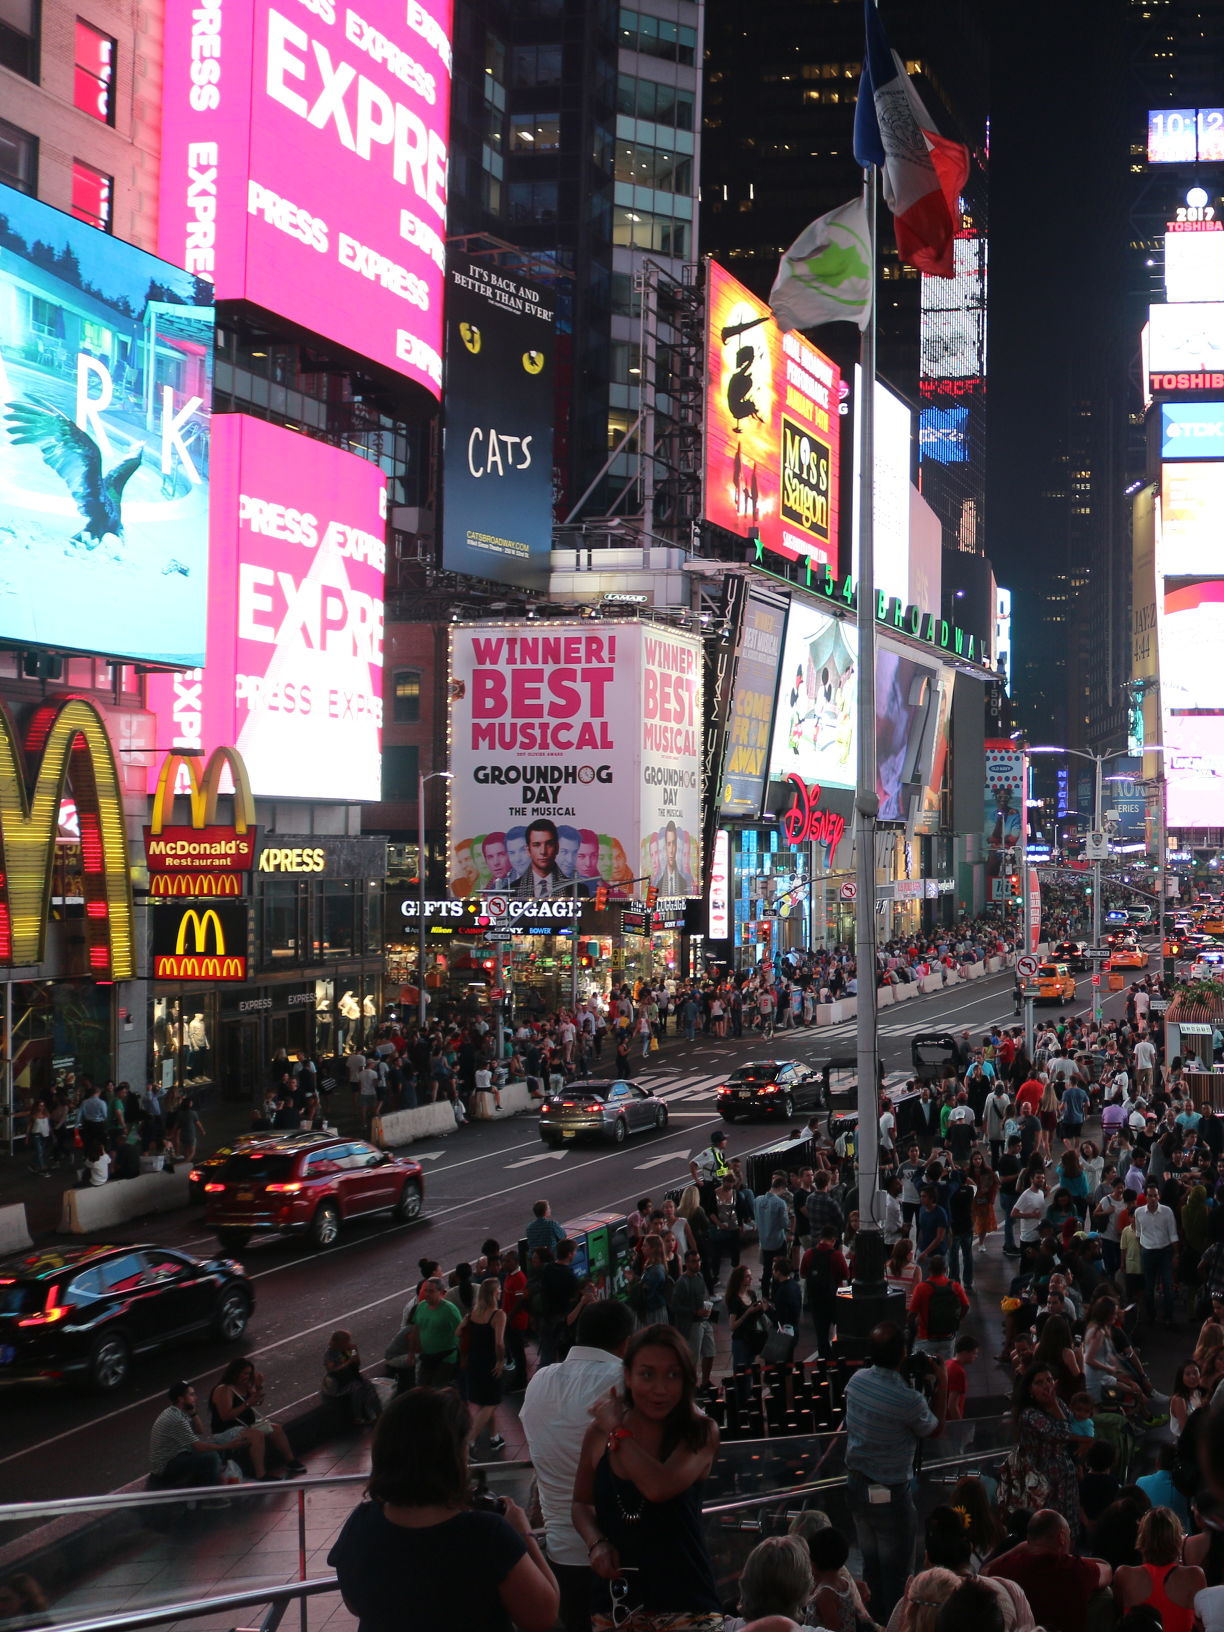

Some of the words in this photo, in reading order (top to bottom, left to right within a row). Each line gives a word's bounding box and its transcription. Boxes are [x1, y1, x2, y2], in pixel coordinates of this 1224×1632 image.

[345, 8, 436, 105] EXPRESS
[1176, 207, 1216, 221] 2017
[1166, 220, 1224, 232] TOSHIBA
[338, 232, 430, 311] EXPRESS
[469, 264, 489, 282] IT'S
[491, 273, 517, 295] BACK
[518, 286, 540, 303] AND
[494, 289, 523, 310] THAN
[838, 402, 849, 415] G
[467, 426, 534, 478] CATS
[607, 593, 643, 603] LAMAR
[803, 554, 853, 605] 154
[876, 588, 987, 661] BROADWAY
[471, 635, 617, 666] WINNER!
[1133, 633, 1151, 662] 4:44
[471, 666, 614, 720] BEST
[643, 668, 697, 727] BEST
[735, 688, 772, 722] COME
[471, 721, 614, 751] MUSICAL
[643, 723, 697, 758] MUSICAL
[727, 744, 767, 776] AWAY
[473, 764, 613, 785] GROUNDHOG
[643, 765, 697, 789] GROUNDHOG
[522, 785, 562, 804] DAY
[662, 787, 679, 806] DAY
[508, 807, 527, 816] THE
[531, 806, 576, 817] MUSICAL
[657, 807, 665, 817] THE
[666, 807, 684, 818] MUSICAL
[149, 839, 249, 856] McDonald's
[165, 857, 232, 867] Restaurant
[430, 926, 453, 934] Nikon
[239, 998, 273, 1012] EXPRESS
[287, 992, 318, 1005] EXPRESS
